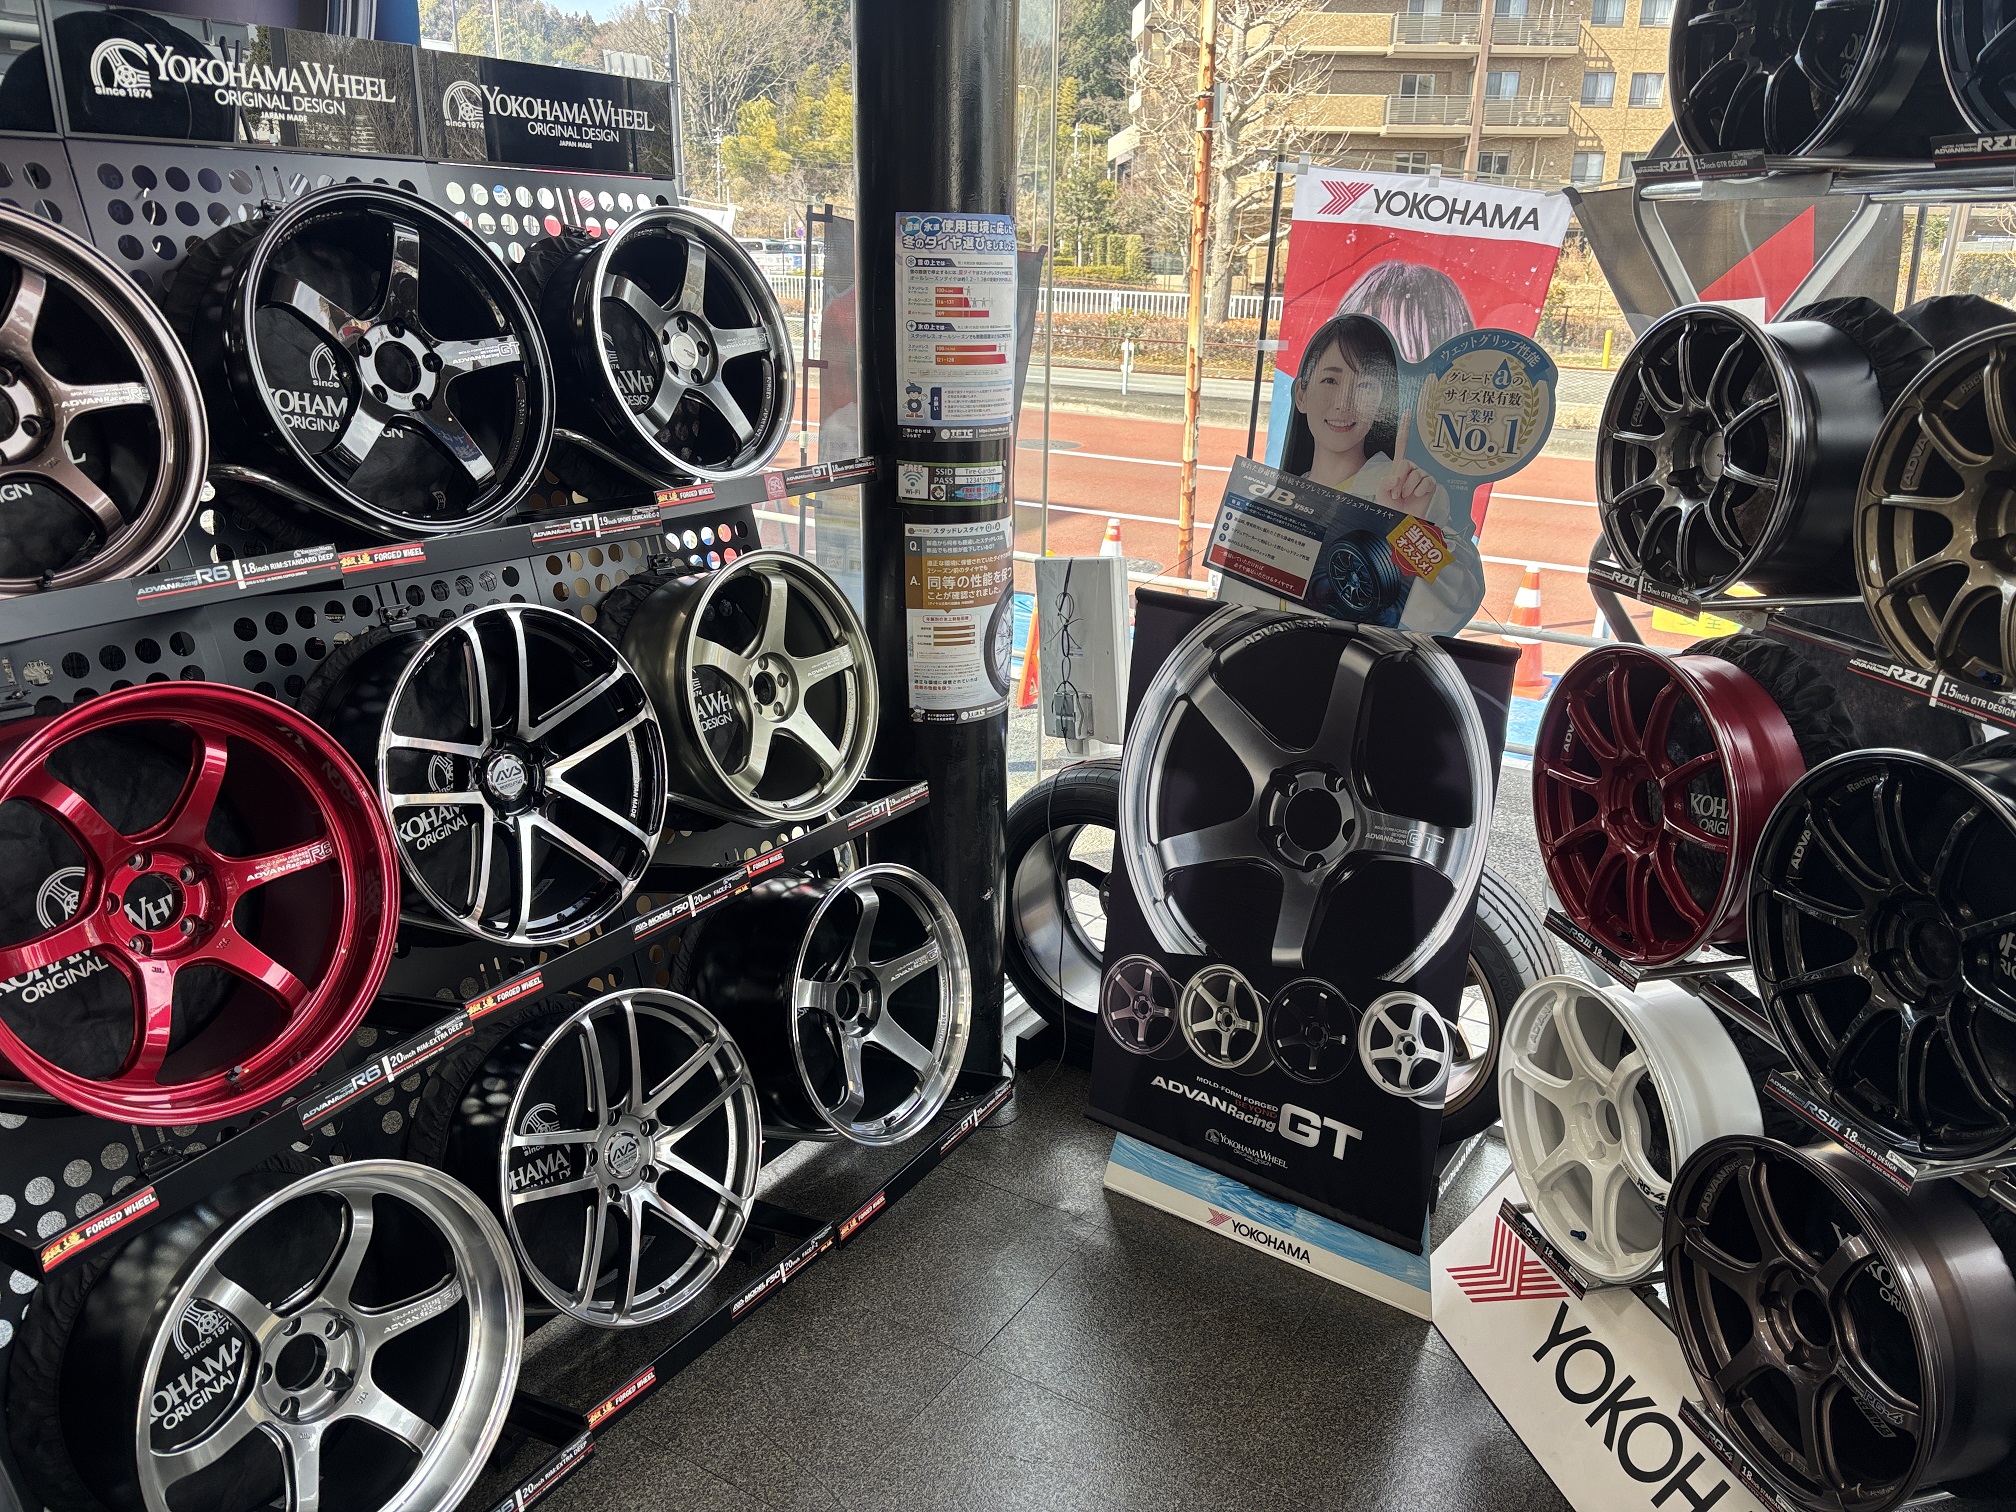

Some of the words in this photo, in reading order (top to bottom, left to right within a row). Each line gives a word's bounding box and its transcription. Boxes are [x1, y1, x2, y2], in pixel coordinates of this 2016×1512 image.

[95, 86, 126, 98] since
[126, 88, 153, 99] 1974
[215, 88, 290, 111] ORIGINAL
[293, 97, 346, 116] DESIGN
[261, 111, 285, 121] JAPAN
[287, 113, 308, 123] MADE
[445, 120, 466, 128] since
[467, 121, 484, 129] 1974
[528, 121, 580, 139] ORIGINAL
[582, 127, 619, 143] DESIGN
[559, 140, 577, 148] JAPAN
[1728, 159, 1748, 168] DESIGN
[1372, 188, 1540, 231] YOKOHAMA
[1440, 334, 1541, 368] ウェットグリップ性能
[312, 378, 340, 388] since
[61, 398, 103, 408] ADVAN
[1445, 389, 1522, 406] サイズ保有数
[1469, 410, 1495, 423] 業界
[904, 464, 922, 473] FREE
[680, 489, 698, 500] FORGED
[698, 487, 714, 496] WHEEL
[570, 517, 593, 532] GT
[374, 551, 402, 563] FORGED
[402, 547, 424, 558] WHEEL
[1405, 524, 1444, 564] 当店の
[137, 583, 175, 595] ADVAN
[196, 565, 231, 585] R6
[318, 552, 334, 562] DEEP
[927, 566, 1012, 590] 同等の性能を保つ
[1660, 591, 1671, 599] GTR
[1671, 593, 1688, 605] DESIGN
[1850, 659, 1871, 670] ADVAN
[1970, 697, 1986, 709] GTR
[630, 798, 638, 819] MADE
[871, 801, 886, 816] GT
[1365, 833, 1389, 841] ADVAN
[1406, 829, 1445, 852] GT
[247, 865, 286, 882] ADVAN
[286, 859, 310, 869] Racing
[753, 858, 769, 870] FORGED
[769, 853, 784, 864] WHEEL
[648, 909, 673, 927] MODEL
[672, 901, 689, 916] F50
[21, 956, 108, 1004] ORIGINAL
[497, 985, 521, 1002] FORGED
[521, 976, 542, 992] WHEEL
[302, 1097, 336, 1121] ADVAN
[350, 1064, 382, 1091] R6
[416, 1031, 449, 1053] RIM:EXTRA
[448, 1021, 464, 1035] DEEP
[1196, 1076, 1242, 1100] MOLD-FORM
[1243, 1096, 1279, 1112] FORGED
[1150, 1075, 1228, 1114] ADVAN
[1226, 1104, 1276, 1133] Racing
[1278, 1103, 1363, 1161] GT
[1234, 1099, 1277, 1119] BEYOND
[960, 1114, 975, 1132] GT
[1769, 1078, 1792, 1096] ADVAN
[1866, 1146, 1877, 1159] GTR
[1877, 1153, 1898, 1172] DESIGN
[1233, 1148, 1253, 1161] ORIGINAL
[1254, 1156, 1271, 1167] DESIGN
[1637, 1177, 1667, 1202] RG-4
[84, 1208, 122, 1238] FORGED
[124, 1192, 156, 1217] WHEEL
[1231, 1218, 1311, 1264] YOKOHAMA
[1519, 1222, 1540, 1245] RG-4
[744, 1282, 766, 1303] MODEL
[765, 1270, 781, 1287] F50
[384, 1315, 420, 1333] ADVAN
[183, 1336, 211, 1361] since
[615, 1385, 637, 1405] FORGED
[636, 1371, 655, 1389] WHEEL
[1863, 1390, 1904, 1424] RG-4
[573, 1440, 587, 1456] DEEP
[1706, 1430, 1734, 1461] RG-4
